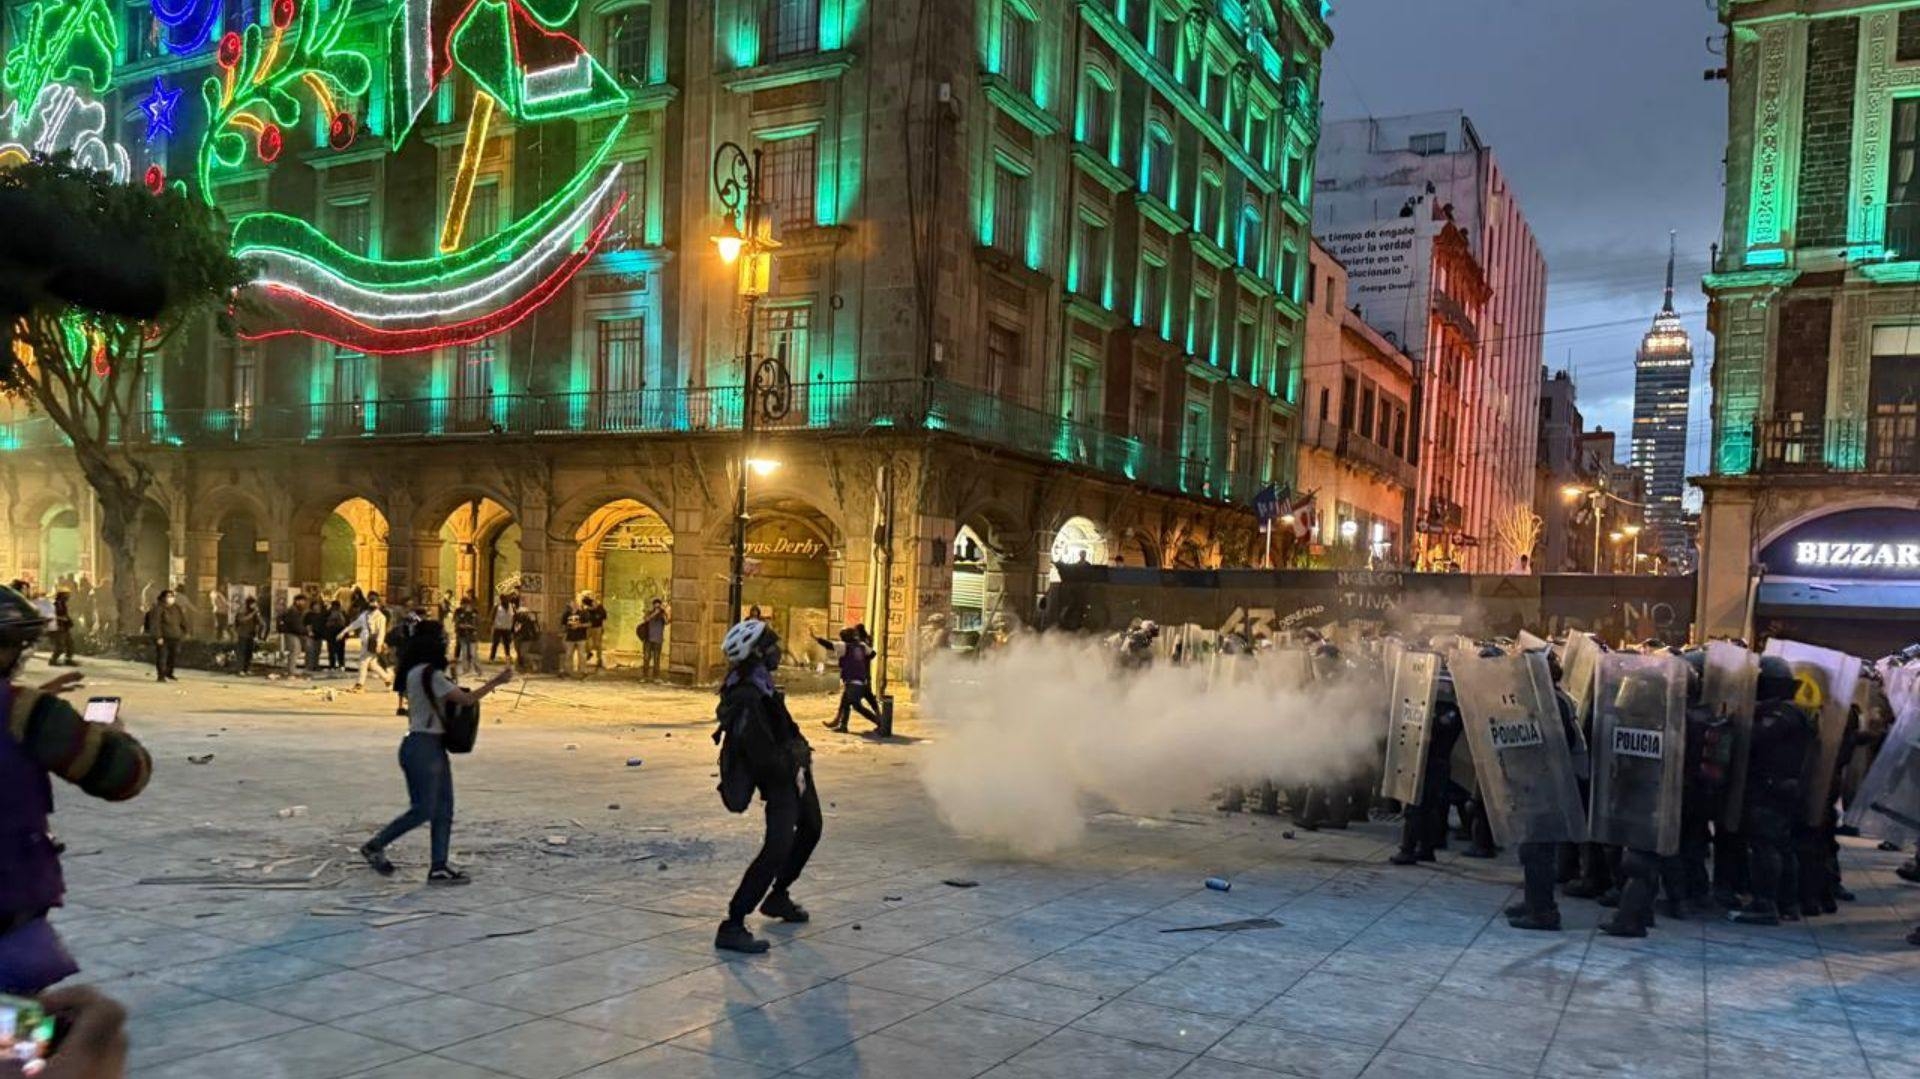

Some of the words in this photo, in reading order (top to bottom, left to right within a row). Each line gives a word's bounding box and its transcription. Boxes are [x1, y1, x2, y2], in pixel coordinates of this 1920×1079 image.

[1328, 231, 1362, 242] tiempo
[1364, 229, 1376, 239] de
[1379, 227, 1415, 239] engaño
[1340, 243, 1365, 254] decir
[1367, 242, 1376, 252] la
[1379, 239, 1412, 250] verdad
[774, 537, 823, 559] Derby
[1796, 542, 1920, 565] BIZZAR
[1623, 601, 1676, 627] NO
[1616, 731, 1660, 754] POLICIA
